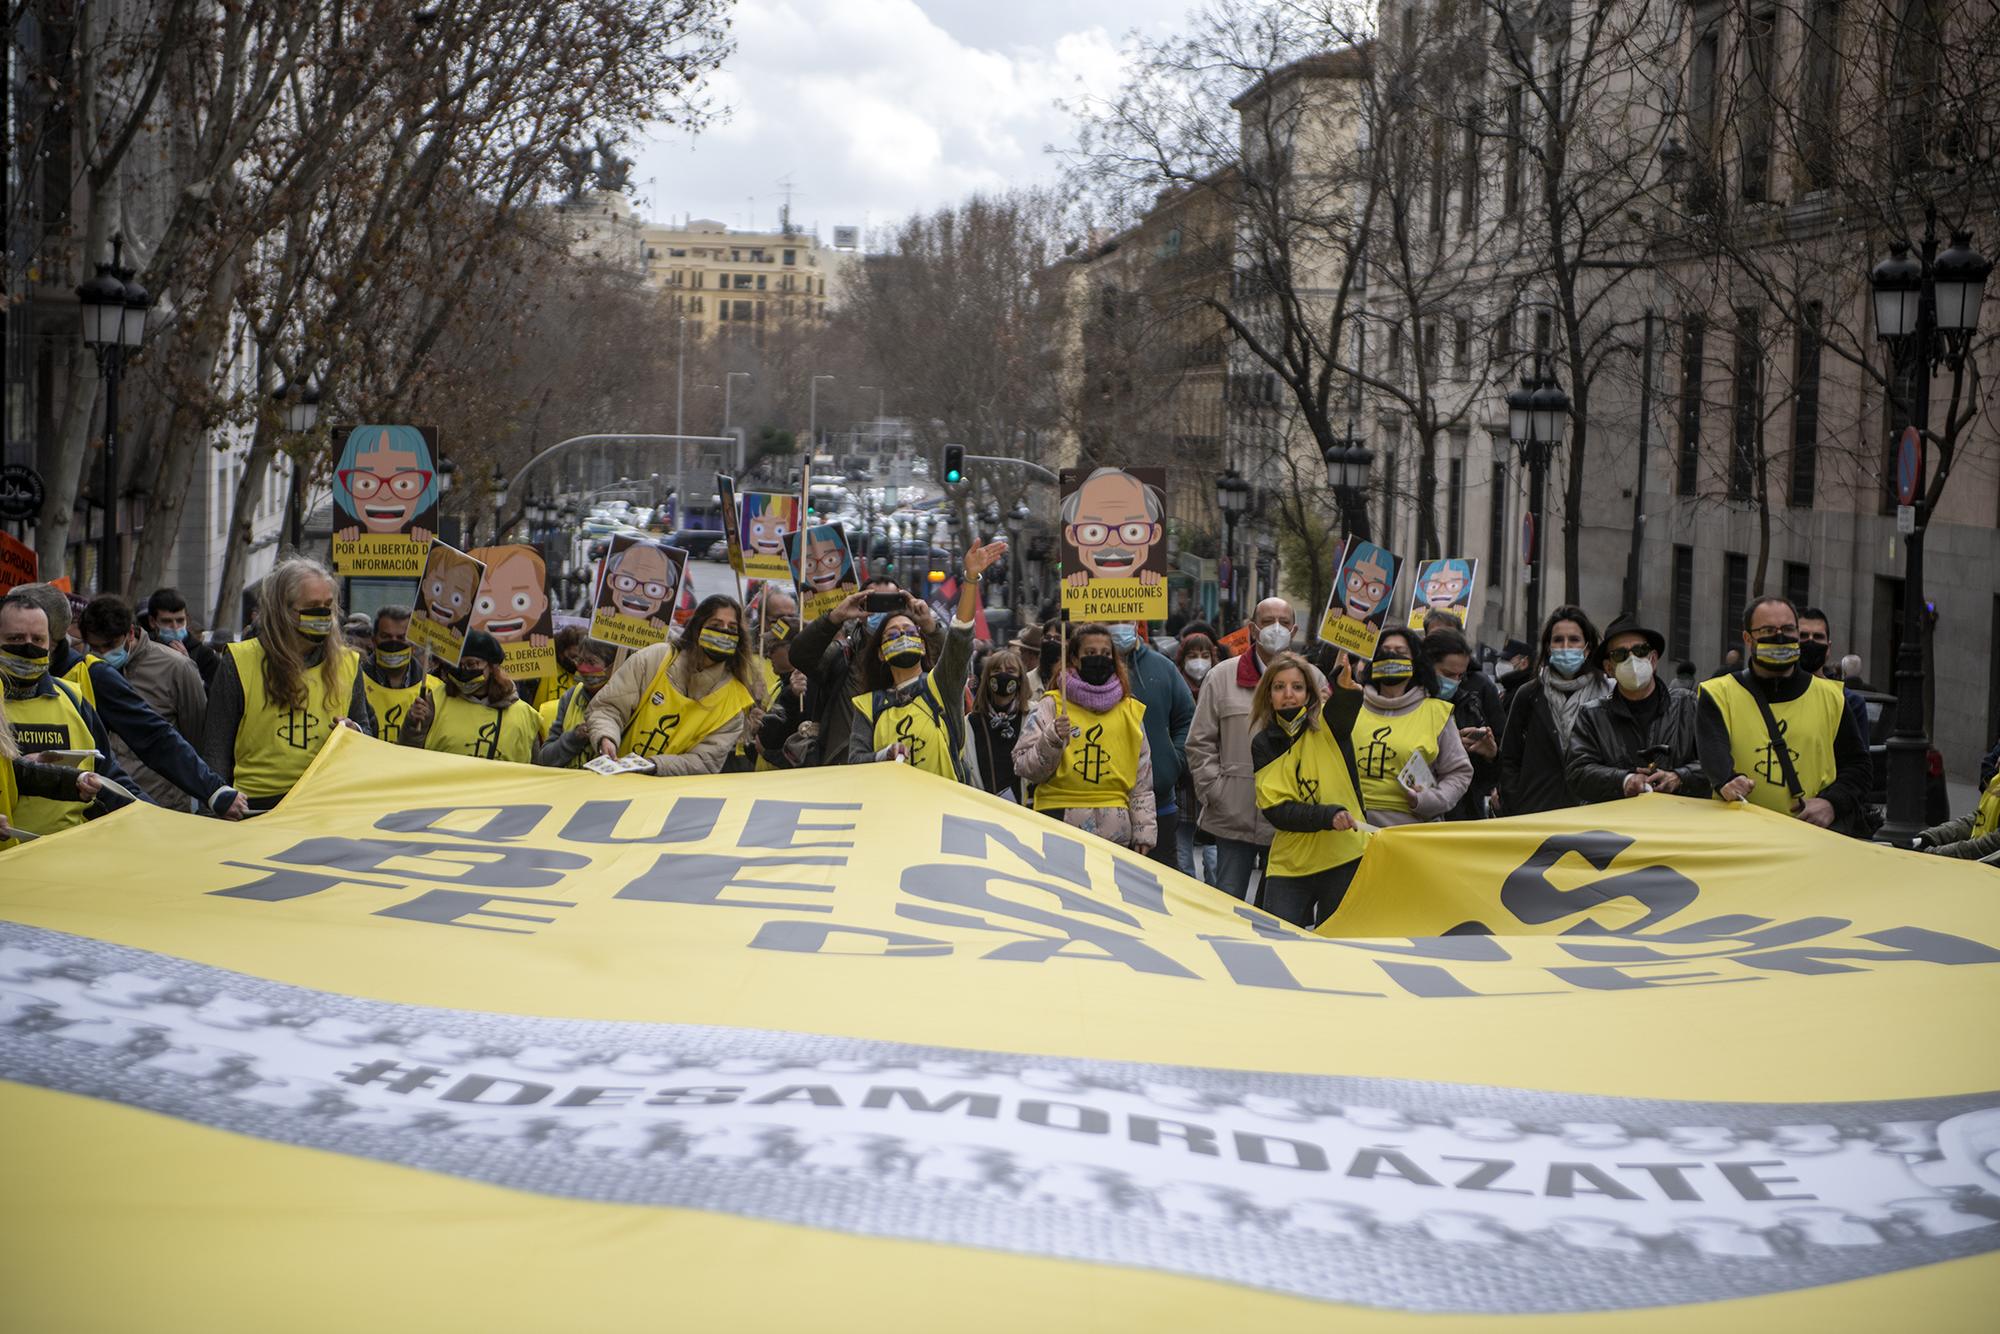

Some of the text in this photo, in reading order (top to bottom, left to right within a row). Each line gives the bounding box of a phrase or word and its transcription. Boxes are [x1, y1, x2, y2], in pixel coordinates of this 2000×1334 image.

[335, 543, 429, 555] POR LA LIBERTAD D
[352, 558, 419, 571] INFORMACIÓN
[1066, 587, 1163, 599] NO A DEVOLUCIONES
[1084, 602, 1145, 614] EN CALIENTE
[595, 615, 665, 640] Defiende el derecho
[1327, 617, 1375, 643] Por la Libertad de
[610, 630, 618, 640] la
[620, 633, 650, 647] Protesta
[1334, 633, 1361, 650] Expresión
[504, 647, 555, 661] EL DERECHO
[18, 730, 64, 744] ACTIVISTA
[373, 797, 863, 848] QUE
[940, 814, 1172, 916] NI
[203, 860, 2000, 998] TE CALLEN
[334, 1058, 1820, 1202] #DESAMORDÁZATE
